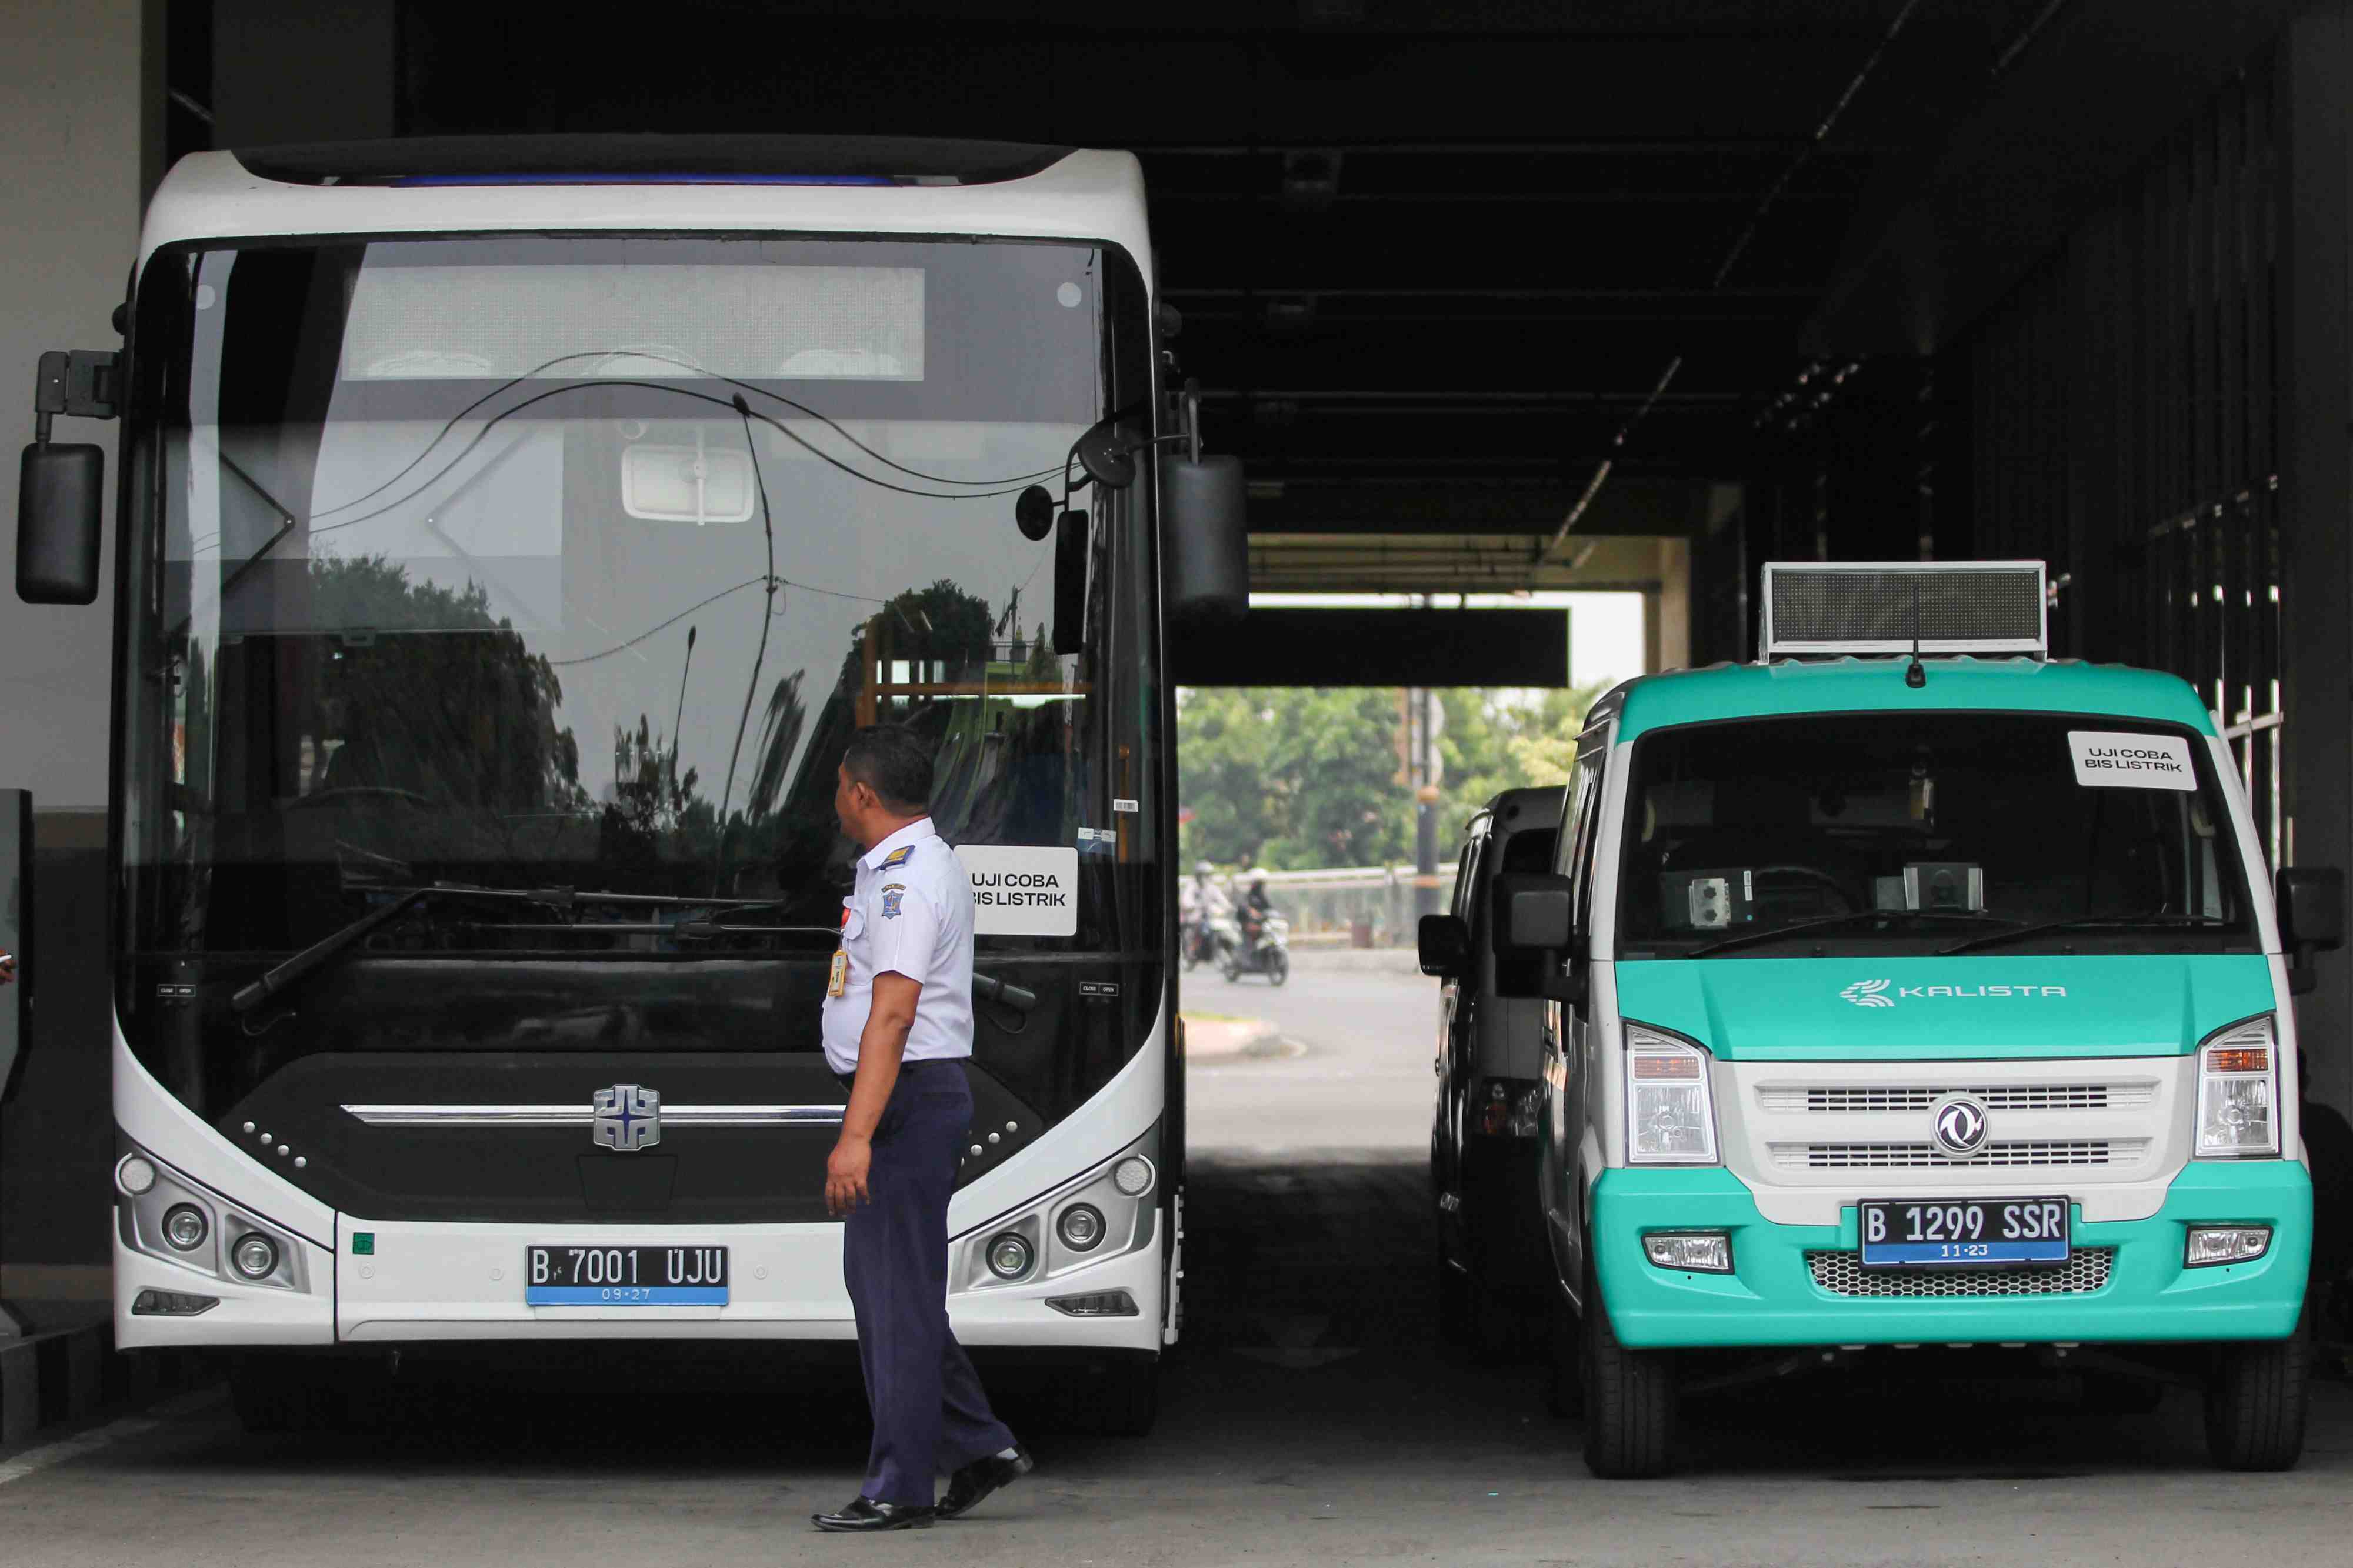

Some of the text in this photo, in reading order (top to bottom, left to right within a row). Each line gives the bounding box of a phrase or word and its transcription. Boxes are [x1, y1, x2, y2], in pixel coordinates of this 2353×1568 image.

[2089, 748, 2173, 760] UJI COBA
[2085, 759, 2183, 773] BIS LISTRIK
[972, 873, 1059, 888] UJI COBA
[996, 892, 1066, 907] LISTRIK
[1899, 985, 2067, 998] KALISTA
[1868, 1203, 2061, 1242] B 1299 SSR
[532, 1249, 722, 1284] B 7001 UJU
